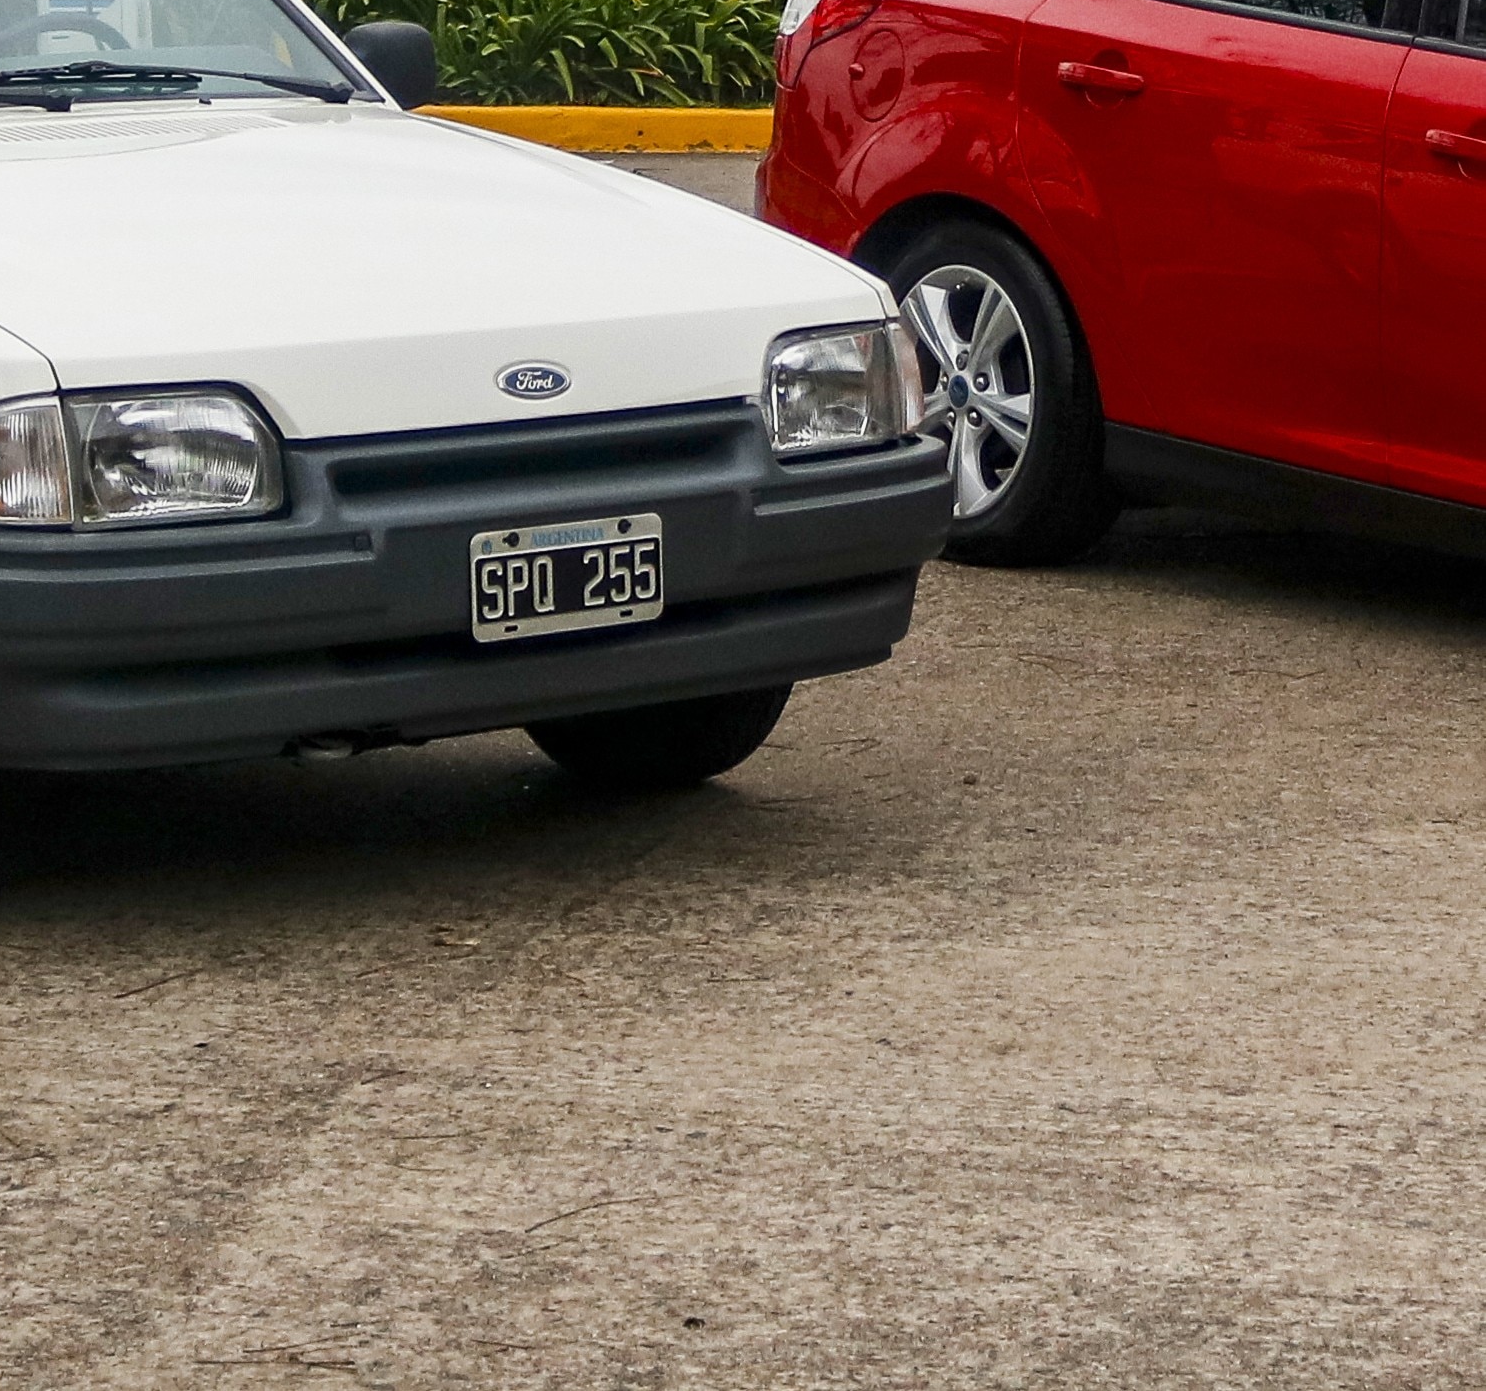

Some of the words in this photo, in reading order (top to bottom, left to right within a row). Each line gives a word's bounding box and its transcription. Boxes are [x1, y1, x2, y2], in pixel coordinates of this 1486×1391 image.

[516, 371, 554, 390] Ford
[530, 527, 605, 547] ARGENTINA
[481, 554, 556, 620] SPQ
[583, 542, 657, 607] 255
